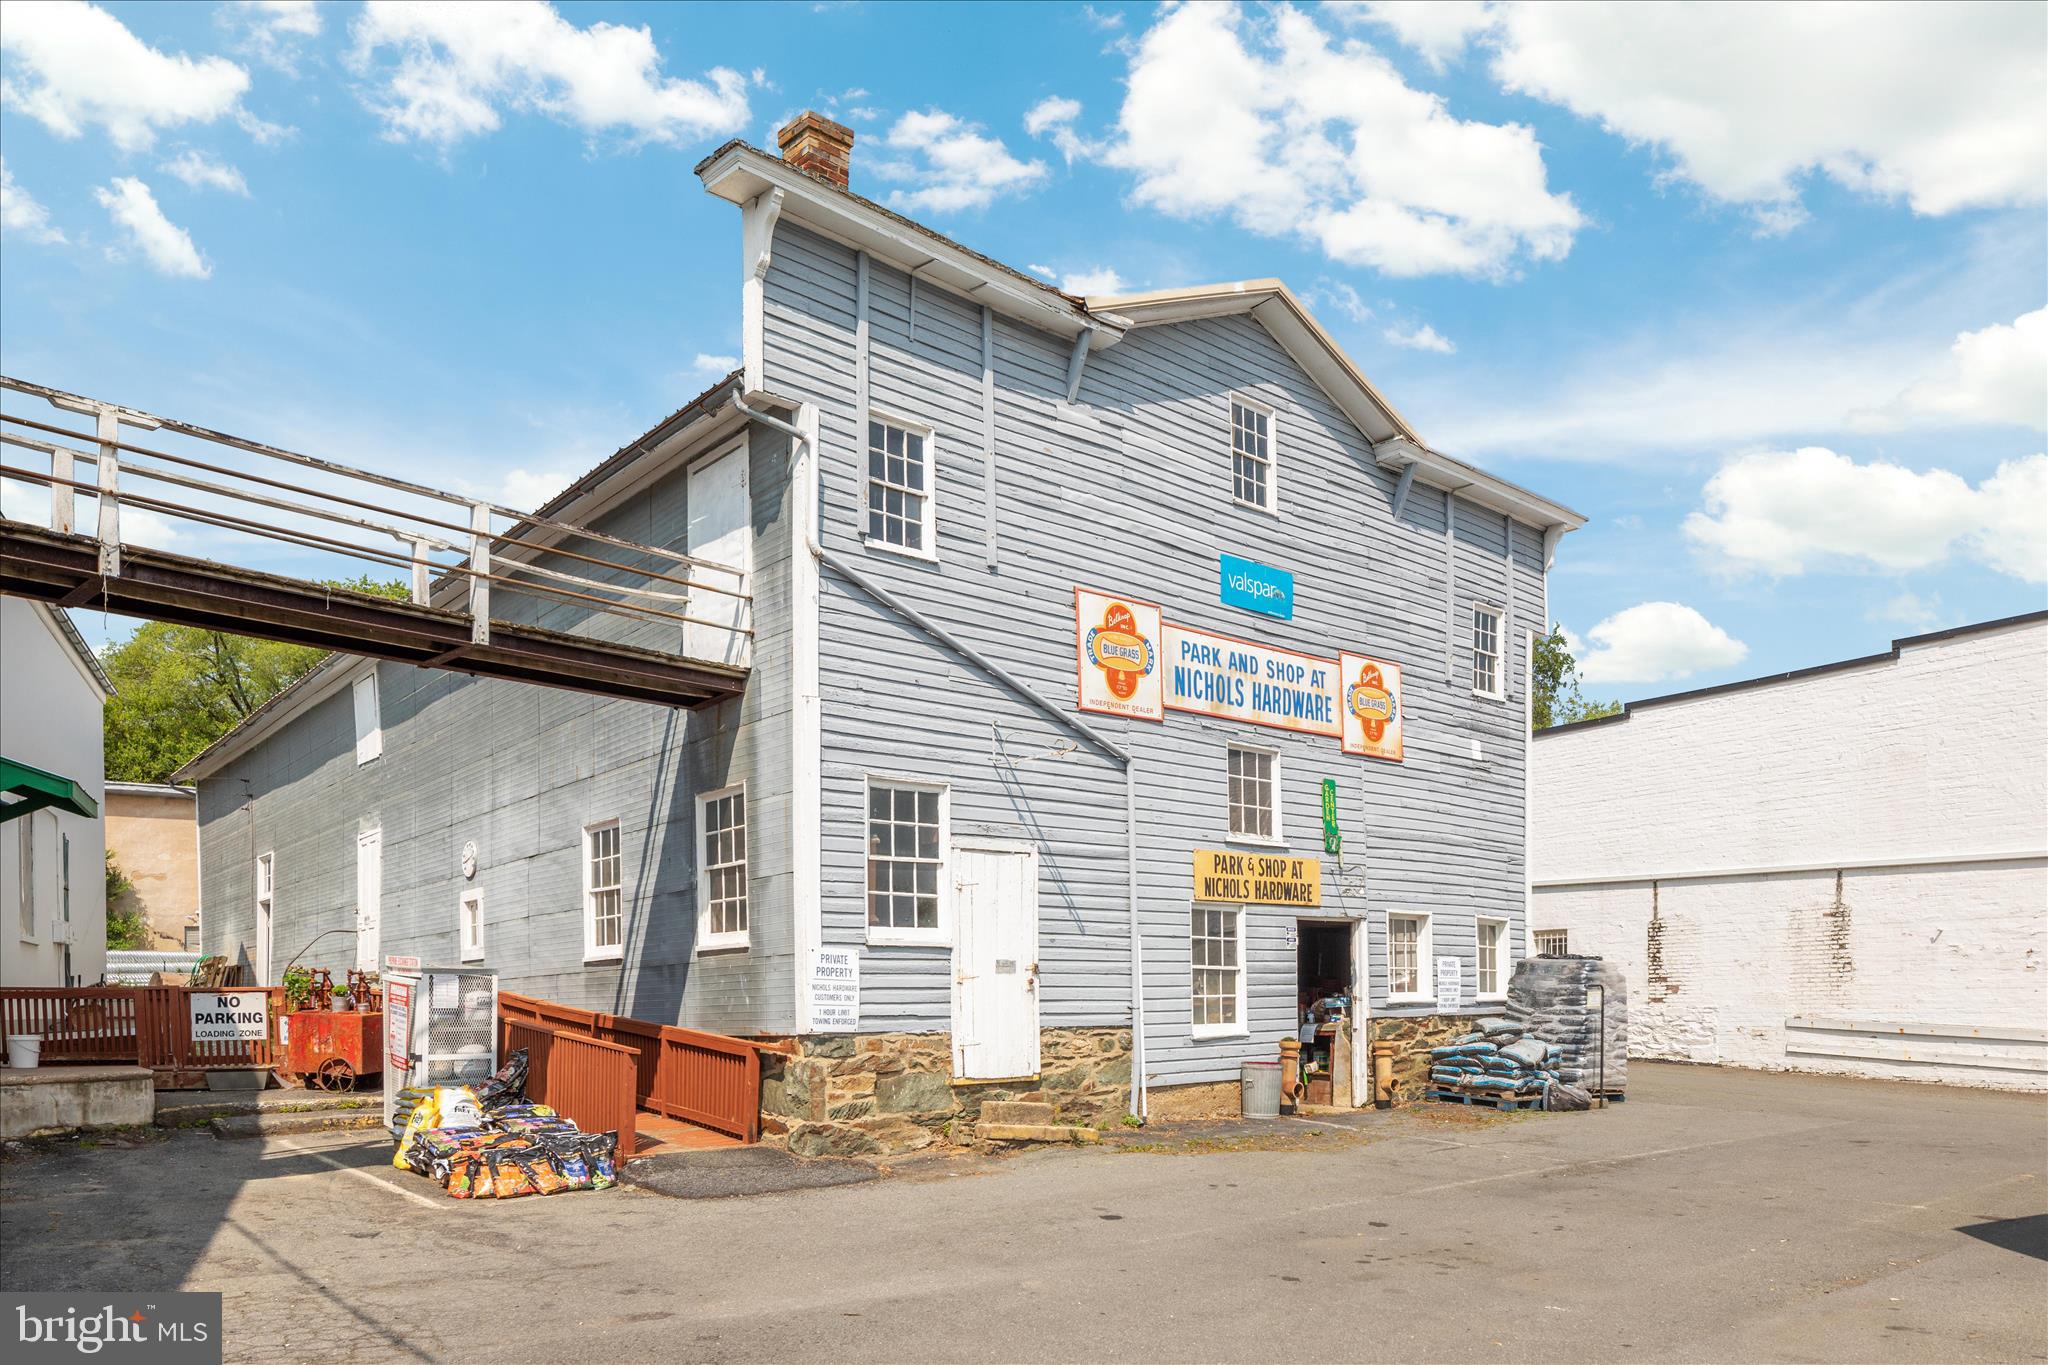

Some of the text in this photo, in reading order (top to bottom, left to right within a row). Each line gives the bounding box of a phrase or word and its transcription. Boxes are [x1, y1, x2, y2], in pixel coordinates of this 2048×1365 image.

[1228, 571, 1278, 600] valspar
[1103, 643, 1140, 660] BLUE GRASS
[1145, 642, 1154, 672] MARK
[1181, 640, 1326, 689] PARK AND SHOP AT
[1174, 665, 1333, 724] NICHOLS HARDWARE
[1089, 698, 1154, 714] INDEPENDENT DEALER
[1359, 696, 1386, 710] BLUE GRASS
[1214, 854, 1304, 879] PARK & SHOP AT
[1204, 877, 1313, 902] NICHOLS HARDWARE
[820, 953, 848, 965] PRIVATE
[816, 966, 852, 977] PROPERTY
[811, 983, 858, 993] NICHOLS HARDWARE
[217, 996, 241, 1008] NO
[814, 993, 843, 1002] CUSTOMERS
[195, 1012, 263, 1024] PARKING
[823, 1008, 836, 1016] HOUR
[812, 1017, 857, 1026] TOWING ENFORCED
[195, 1030, 235, 1038] LOADING
